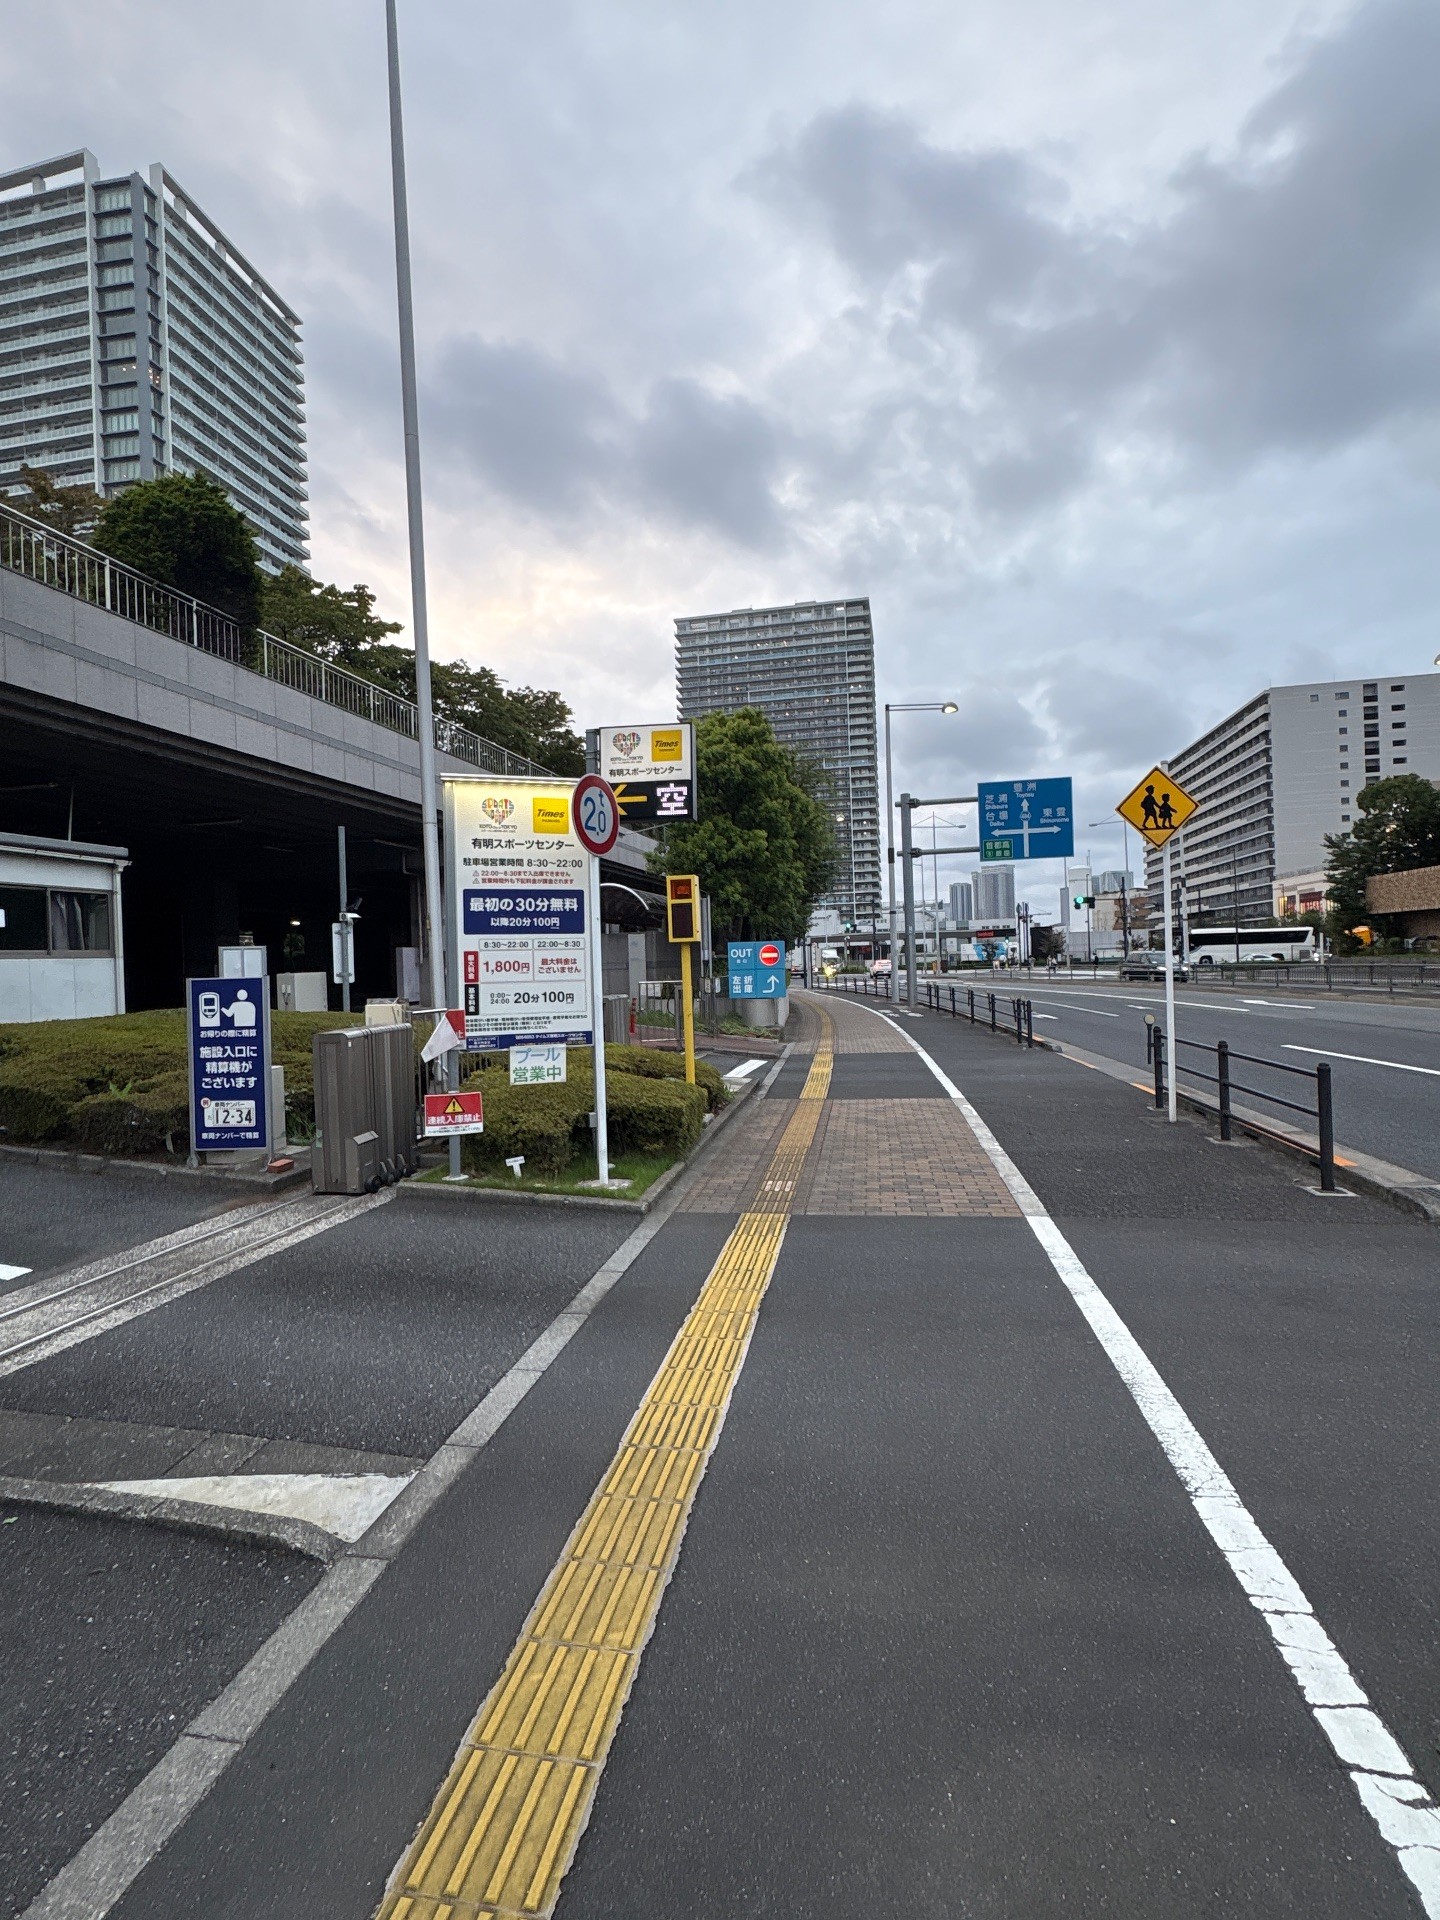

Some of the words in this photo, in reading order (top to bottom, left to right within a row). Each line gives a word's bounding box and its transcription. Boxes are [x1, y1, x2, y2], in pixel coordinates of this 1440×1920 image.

[655, 740, 680, 748] Times
[608, 766, 682, 777] 有明スポーツセンター
[656, 783, 688, 816] 空
[537, 809, 565, 818] Times
[472, 838, 574, 850] 有明スポーツセンター
[463, 858, 524, 867] 駐車場営業時間
[470, 897, 578, 912] 最初の30分無料
[730, 949, 752, 958] OUT
[483, 960, 530, 975] 1,800円
[541, 958, 577, 966] 最大料金は
[538, 966, 581, 974] ございません
[732, 976, 752, 984] 左折
[732, 985, 753, 993] 出庫
[200, 1030, 256, 1038] お帰りの際に精算
[200, 1046, 258, 1058] 施設入口に
[516, 1047, 560, 1064] プール
[206, 1061, 252, 1074] 精算機が
[512, 1065, 561, 1083] 営業中
[202, 1077, 257, 1089] ございます
